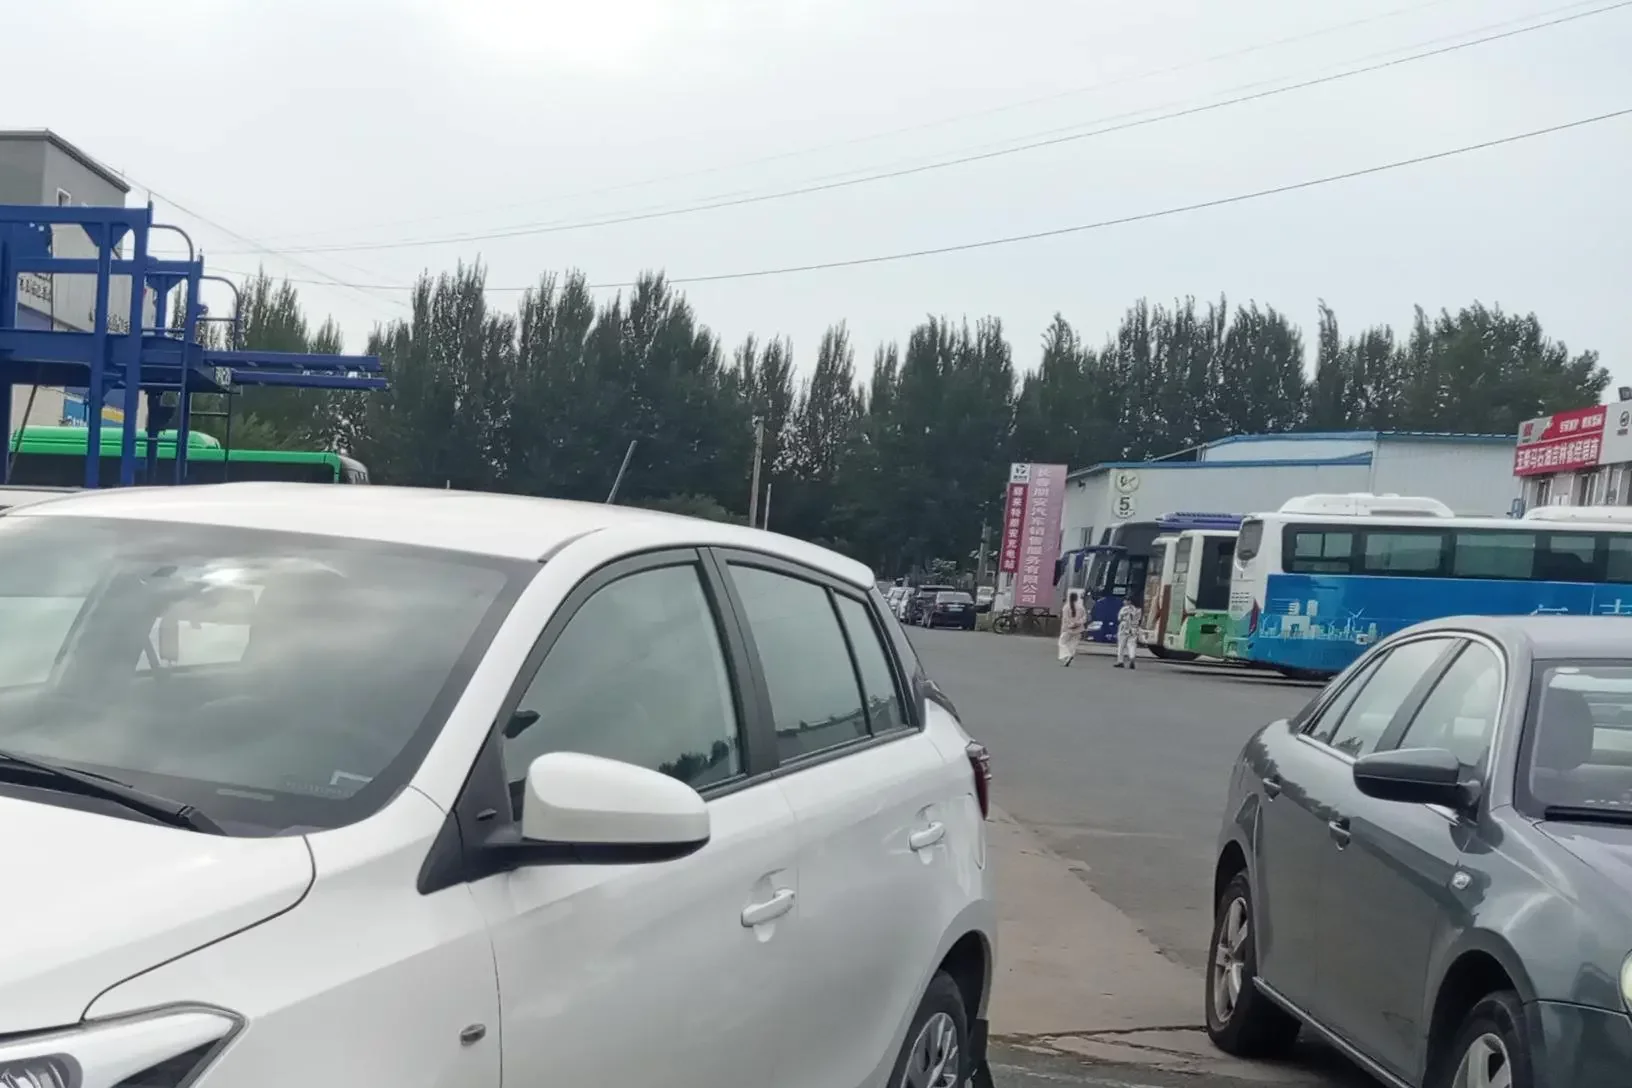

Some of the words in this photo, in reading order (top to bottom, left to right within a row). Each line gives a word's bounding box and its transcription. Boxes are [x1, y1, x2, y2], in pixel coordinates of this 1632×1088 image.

[1021, 467, 1052, 604] 长春朋安汽车销售服务有限公司
[1119, 496, 1130, 512] 5
